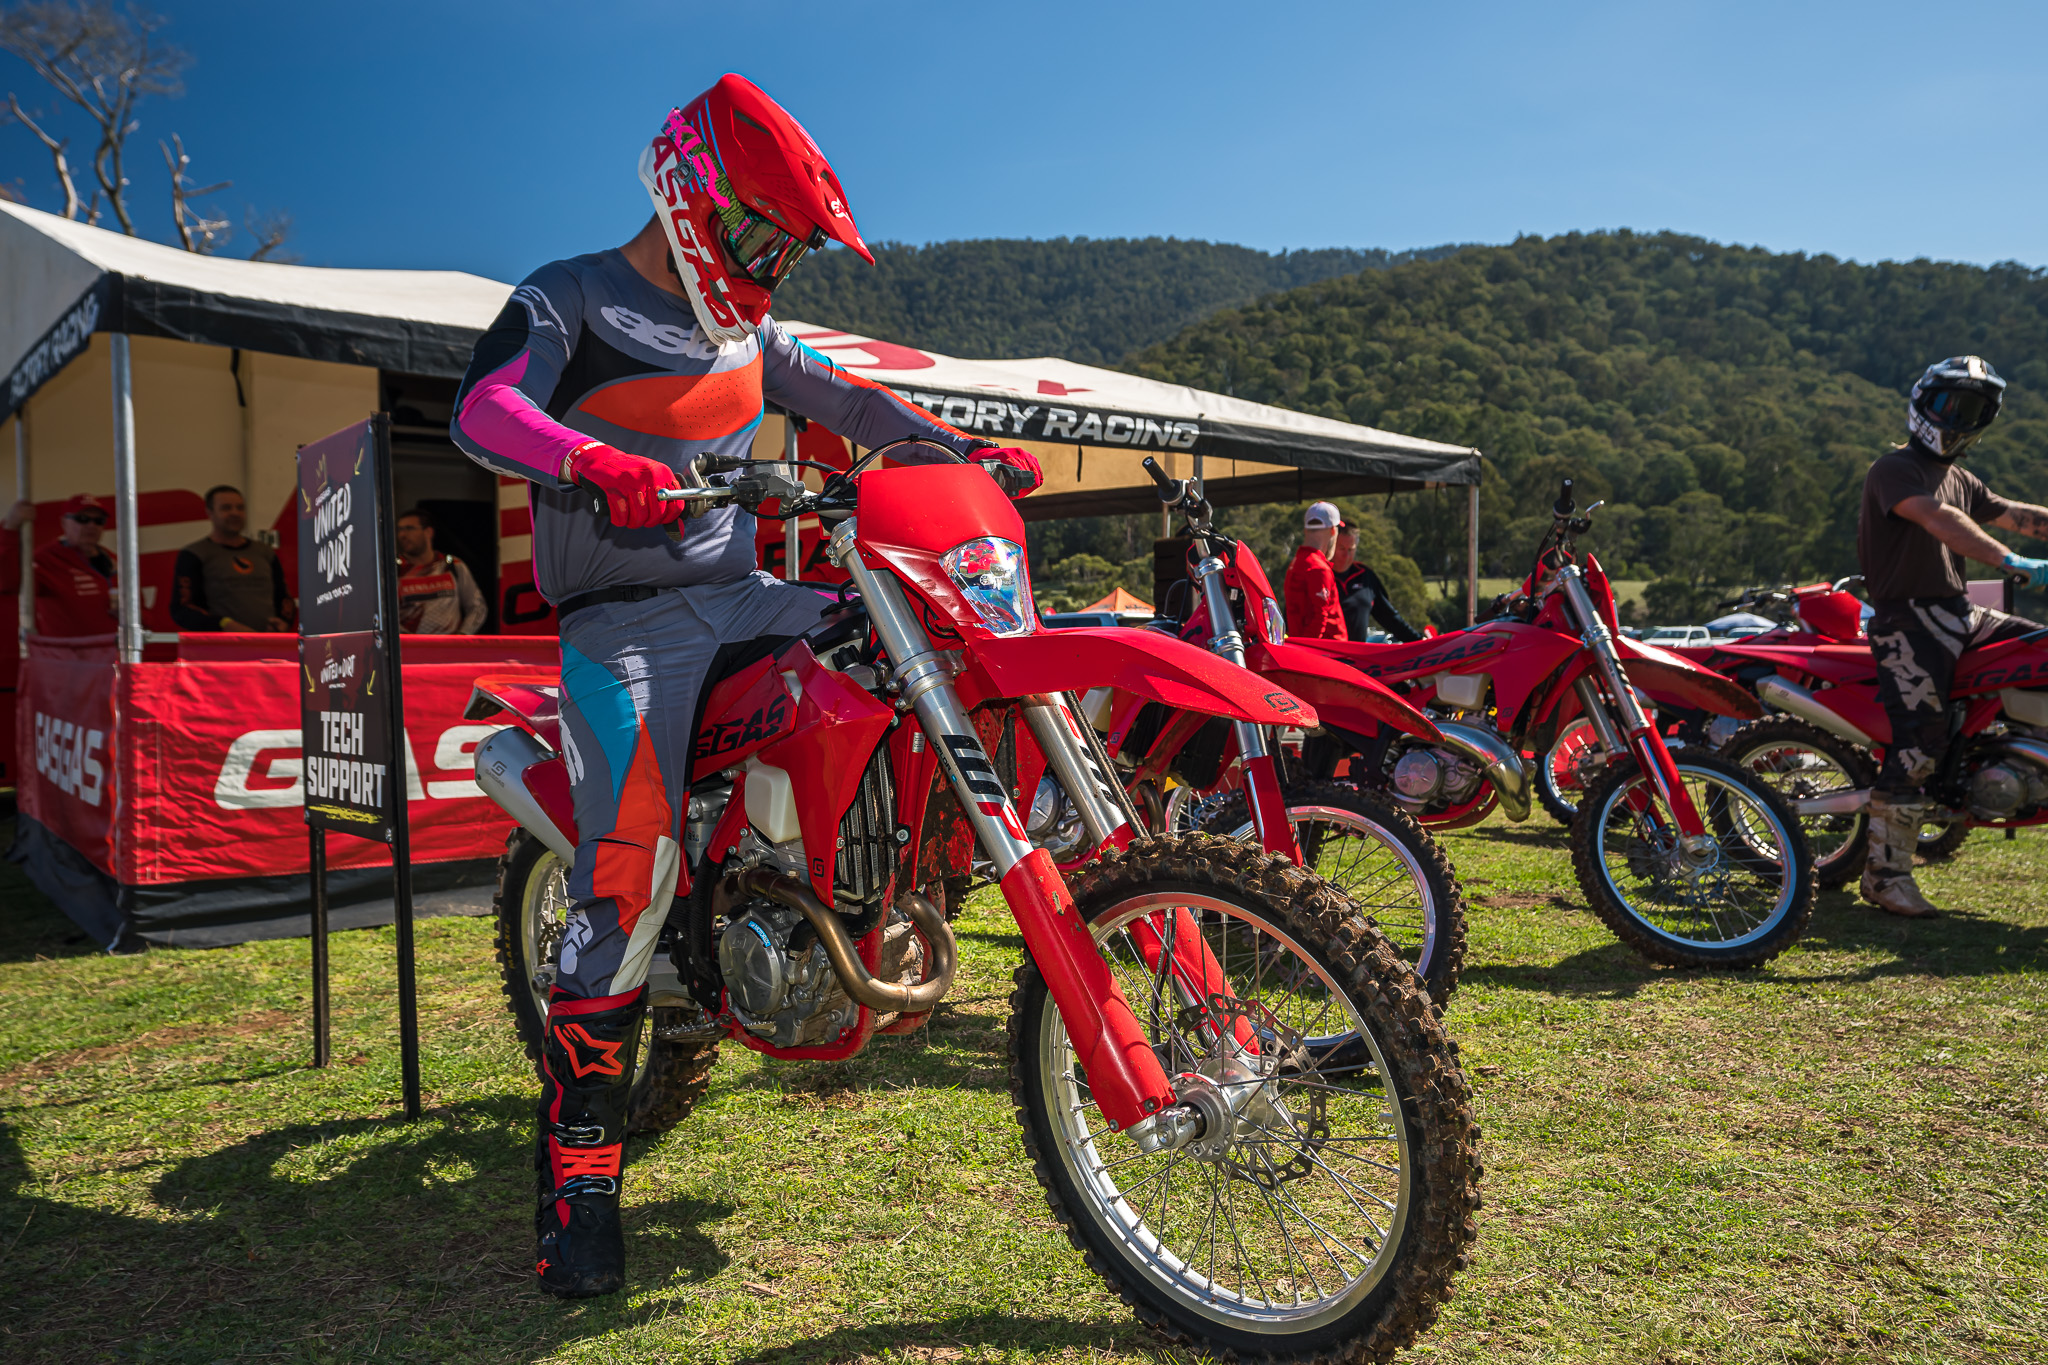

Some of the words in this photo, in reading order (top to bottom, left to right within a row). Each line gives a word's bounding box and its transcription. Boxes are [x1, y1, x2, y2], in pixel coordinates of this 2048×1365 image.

[890, 389, 1040, 434] TORY
[1042, 407, 1200, 449] RACING
[314, 482, 352, 545] UNITED
[327, 524, 354, 583] DIRT
[35, 711, 104, 807] GASGAS
[320, 710, 364, 756] TECH
[306, 755, 386, 808] SUPPORT
